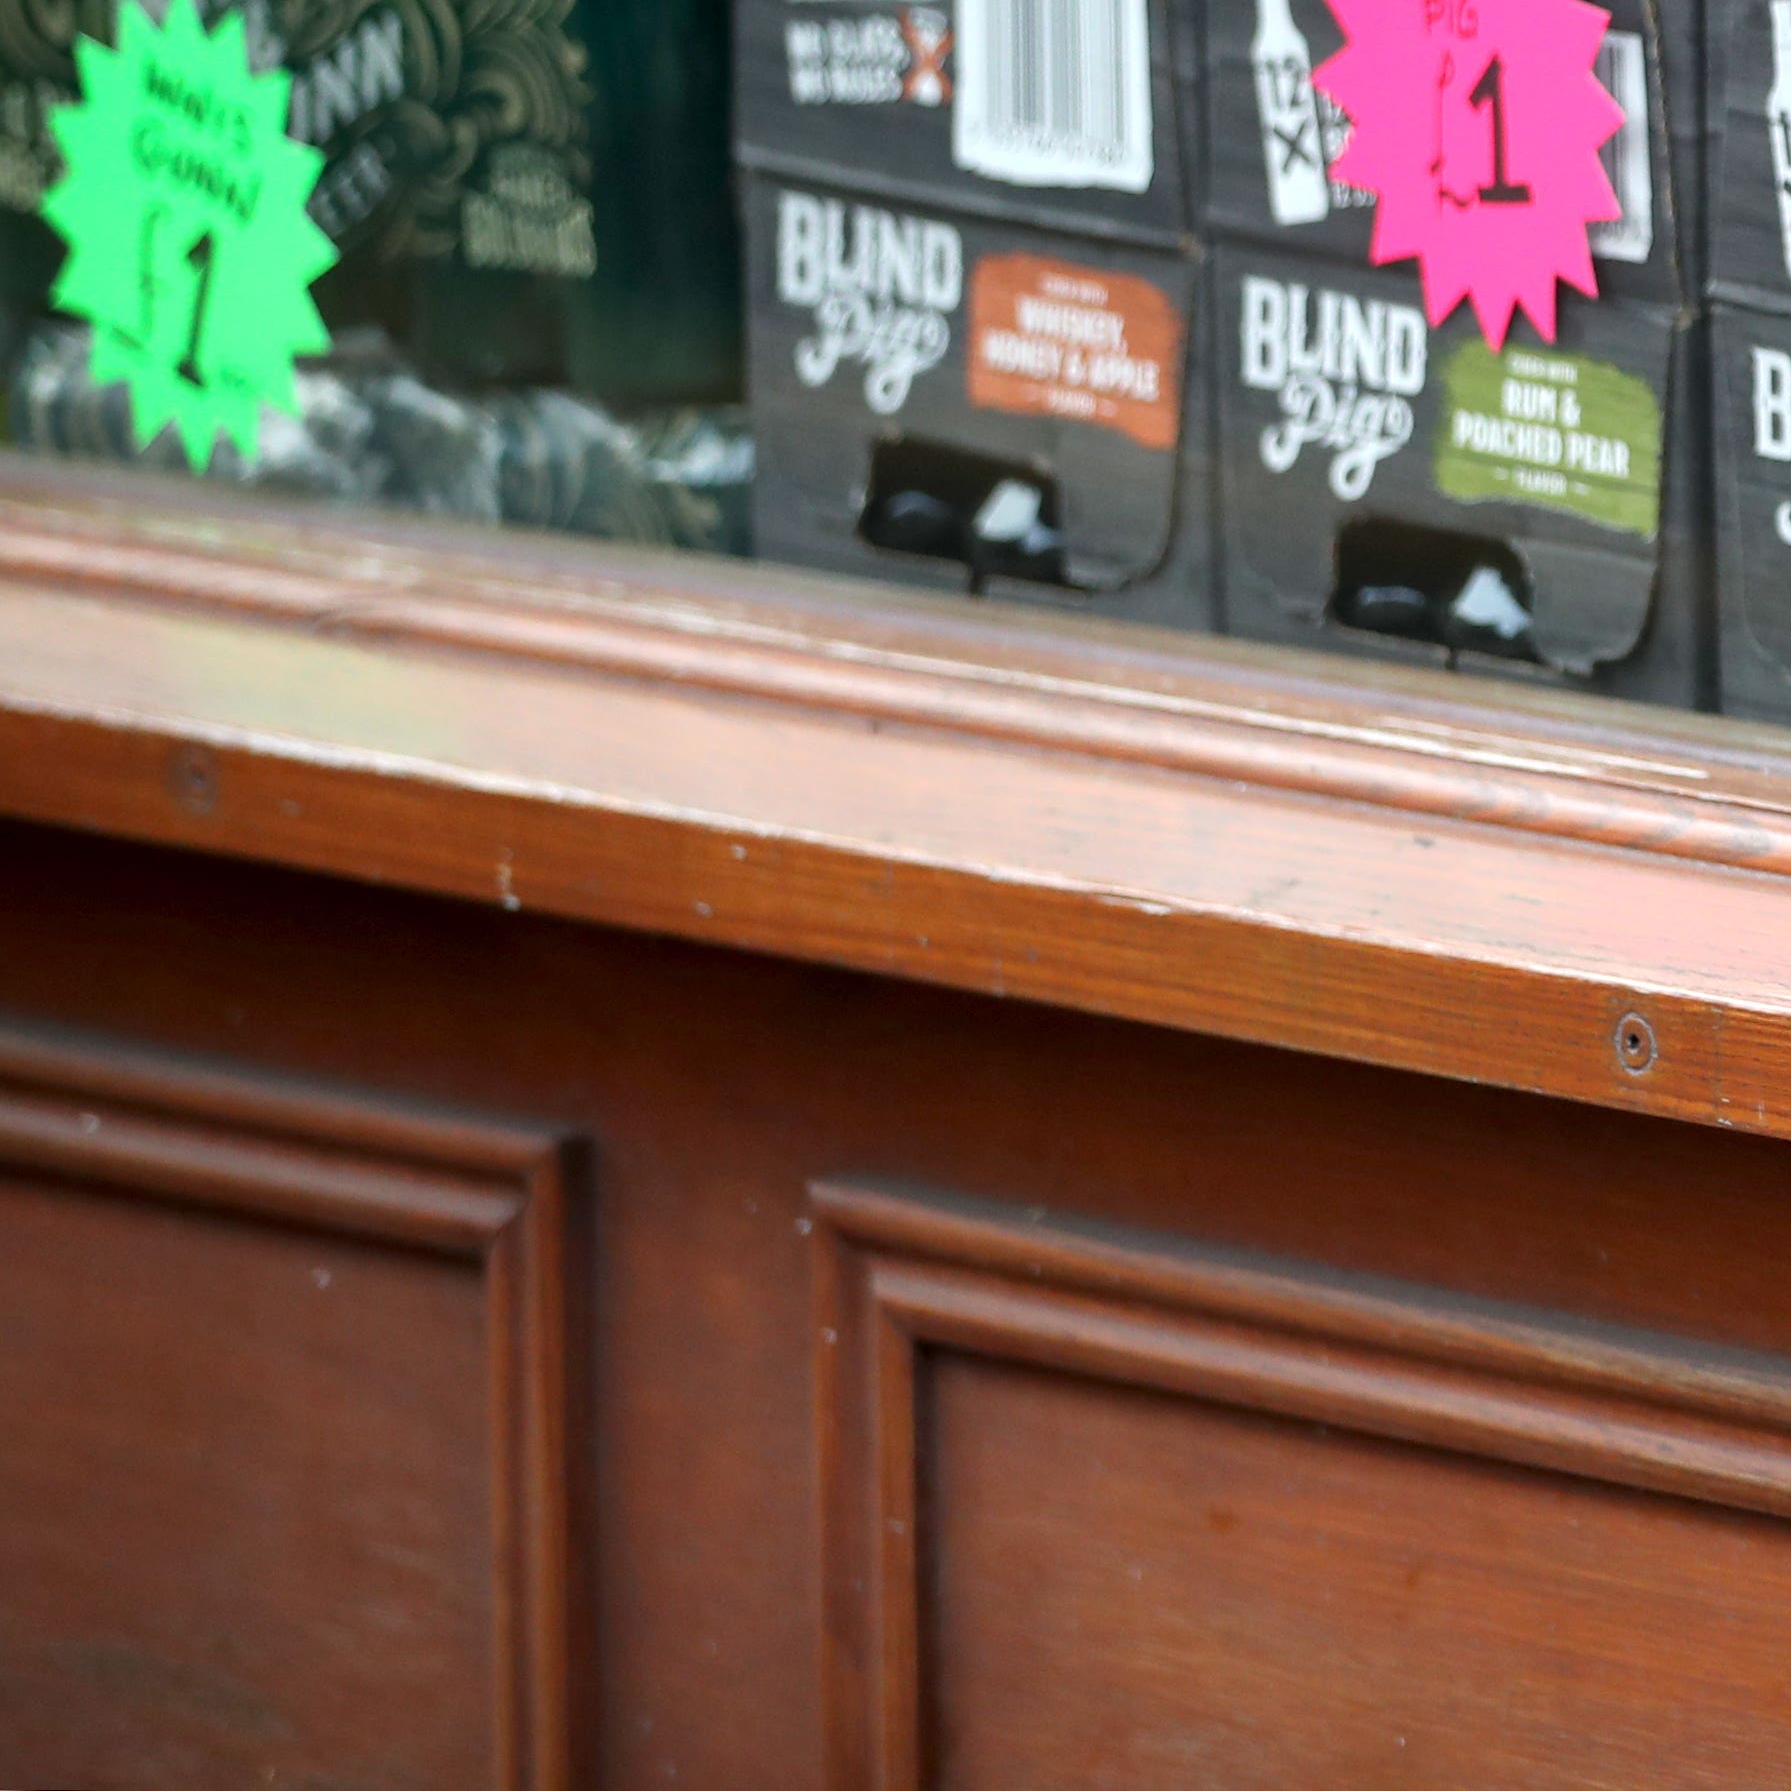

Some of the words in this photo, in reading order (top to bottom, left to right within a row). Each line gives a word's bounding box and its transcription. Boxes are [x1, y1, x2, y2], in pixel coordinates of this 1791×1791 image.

[777, 192, 963, 311] BLIND
[794, 295, 949, 415] Pig
[1240, 273, 1428, 397] BLIND
[1259, 375, 1415, 502] Pig
[1452, 411, 1562, 466] POACHED
[1567, 431, 1631, 480] PEAR
[1503, 379, 1557, 420] RUM
[1560, 389, 1582, 427] &
